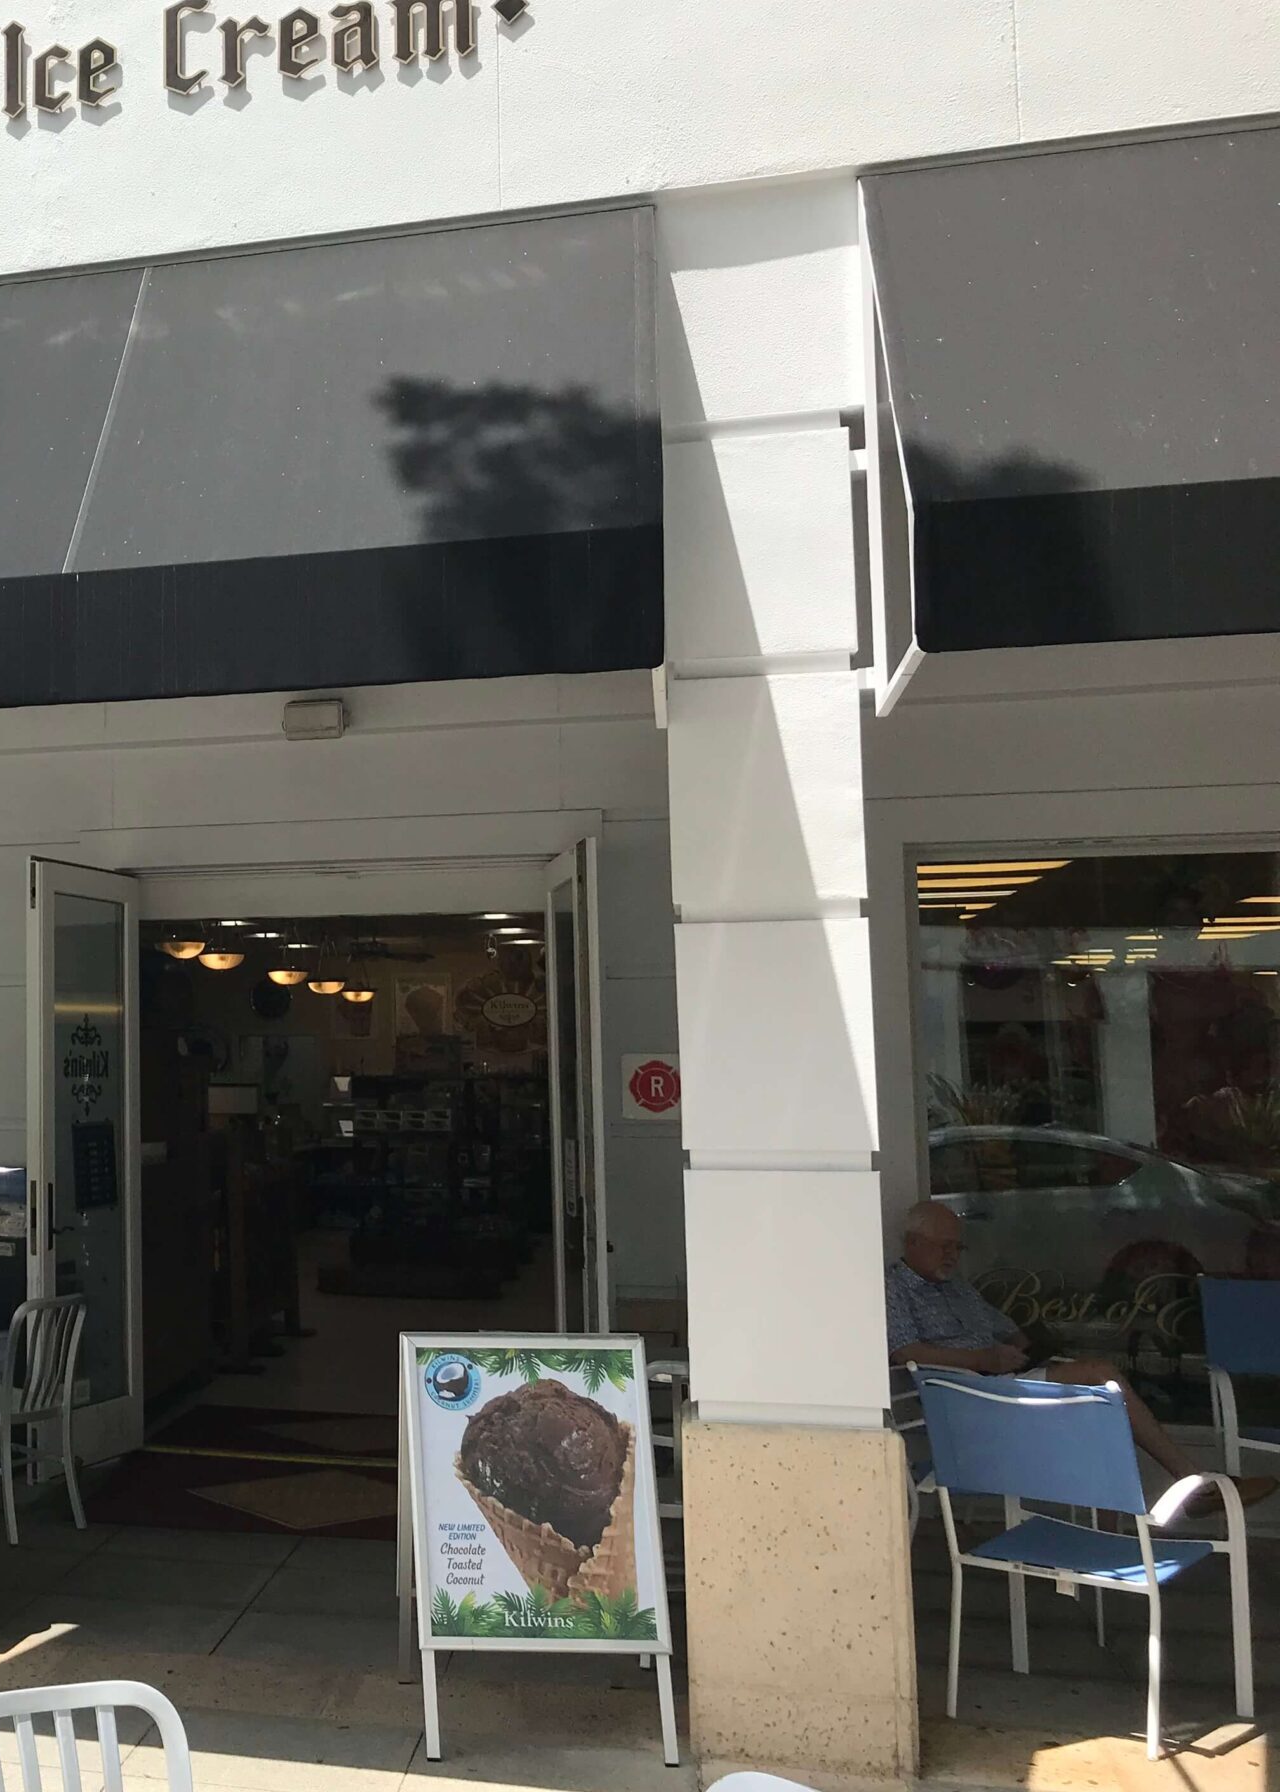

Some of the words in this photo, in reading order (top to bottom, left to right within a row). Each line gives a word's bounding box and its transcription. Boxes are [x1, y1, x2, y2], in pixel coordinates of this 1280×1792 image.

[1, 20, 118, 118] Ice
[163, 0, 480, 95] Cream
[650, 1075, 665, 1097] R
[438, 1523, 456, 1532] NEW
[457, 1523, 485, 1532] LIMITED
[448, 1532, 477, 1540] EDITION
[440, 1542, 486, 1555] Chocolate
[447, 1558, 483, 1570] Toasted
[446, 1573, 485, 1585] Coconut
[504, 1610, 574, 1628] Kilwins
